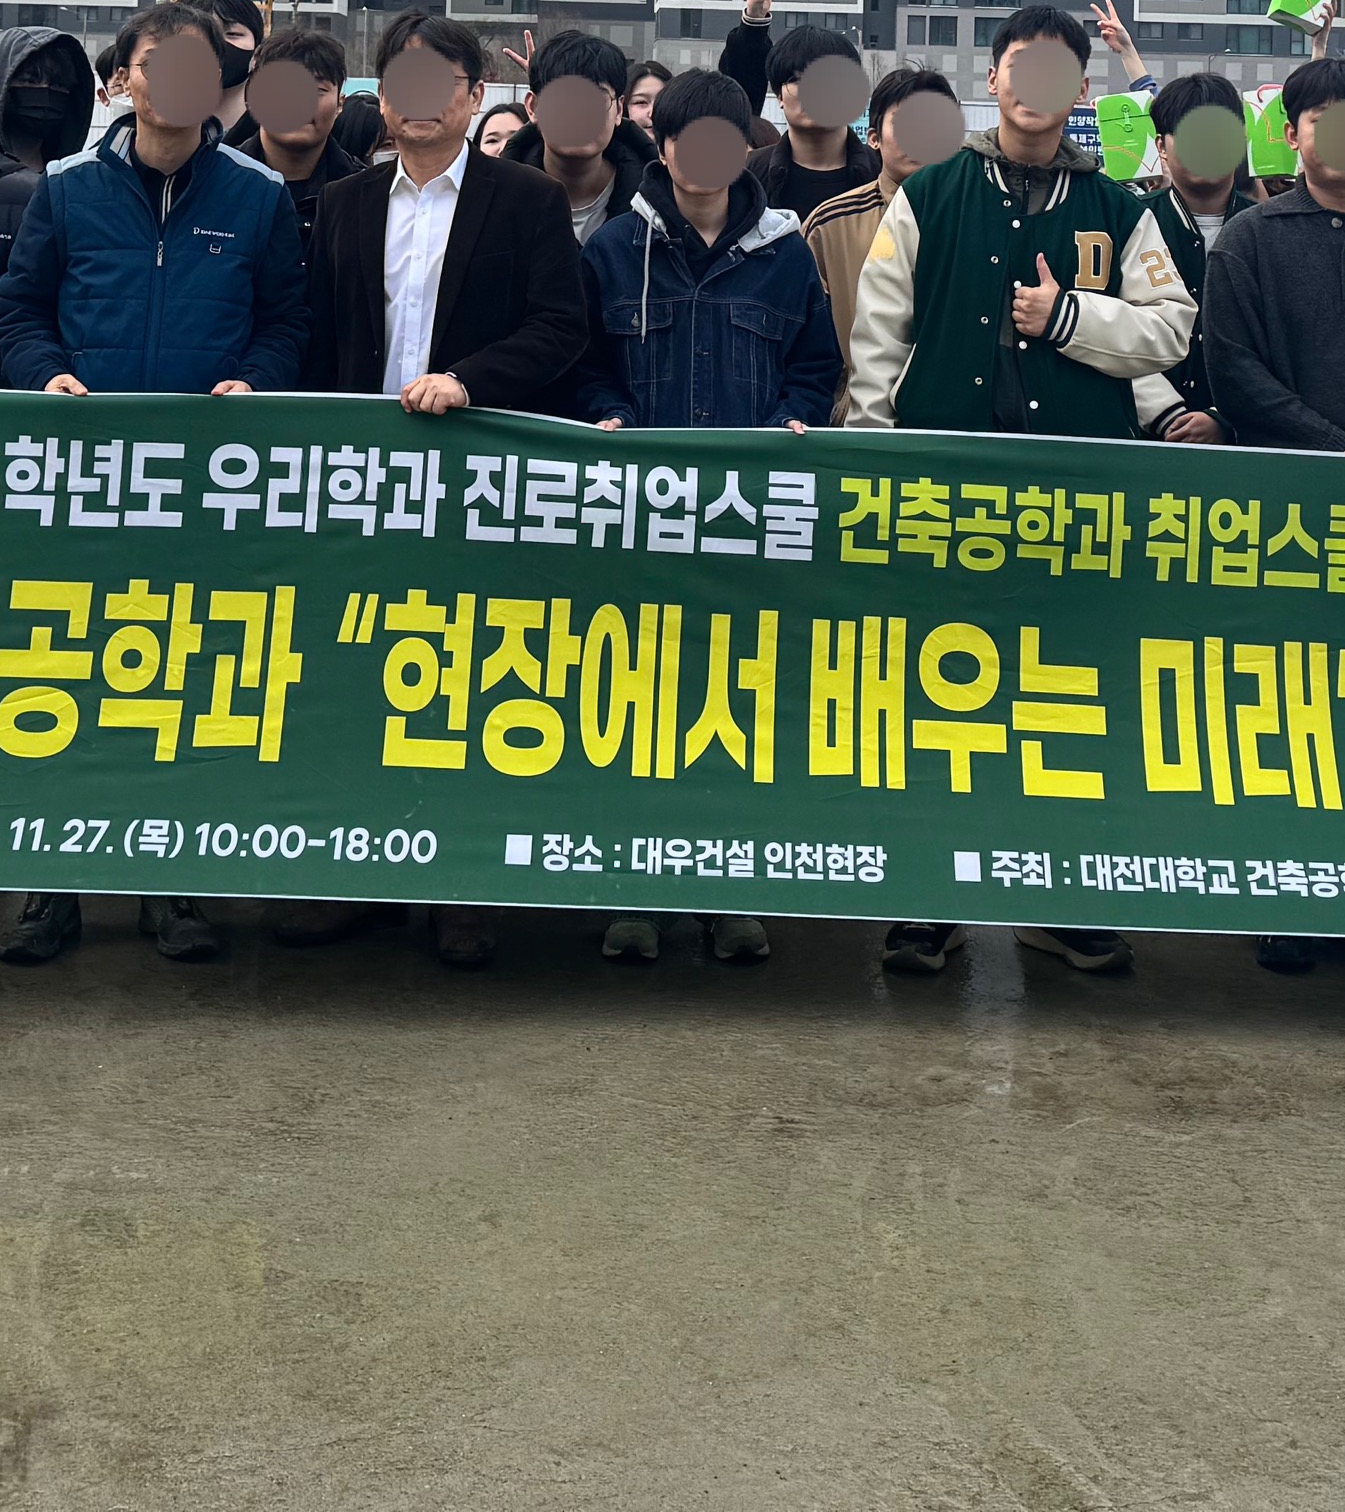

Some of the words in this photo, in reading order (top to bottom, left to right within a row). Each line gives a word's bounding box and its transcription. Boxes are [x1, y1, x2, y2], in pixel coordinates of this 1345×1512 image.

[1074, 230, 1113, 290] D
[202, 444, 446, 537] 우리학과
[462, 452, 819, 561] 진로취업스쿨
[839, 477, 1132, 579] 건축공학과
[808, 615, 1106, 800] 배우는
[9, 818, 52, 852] 11.
[195, 822, 439, 865] 10:00-18:00
[541, 833, 604, 873] 장소
[631, 836, 756, 878] 대우건설
[764, 840, 888, 883] 인천현장
[991, 850, 1053, 889] 주최
[1079, 854, 1240, 895] 대전대학교
